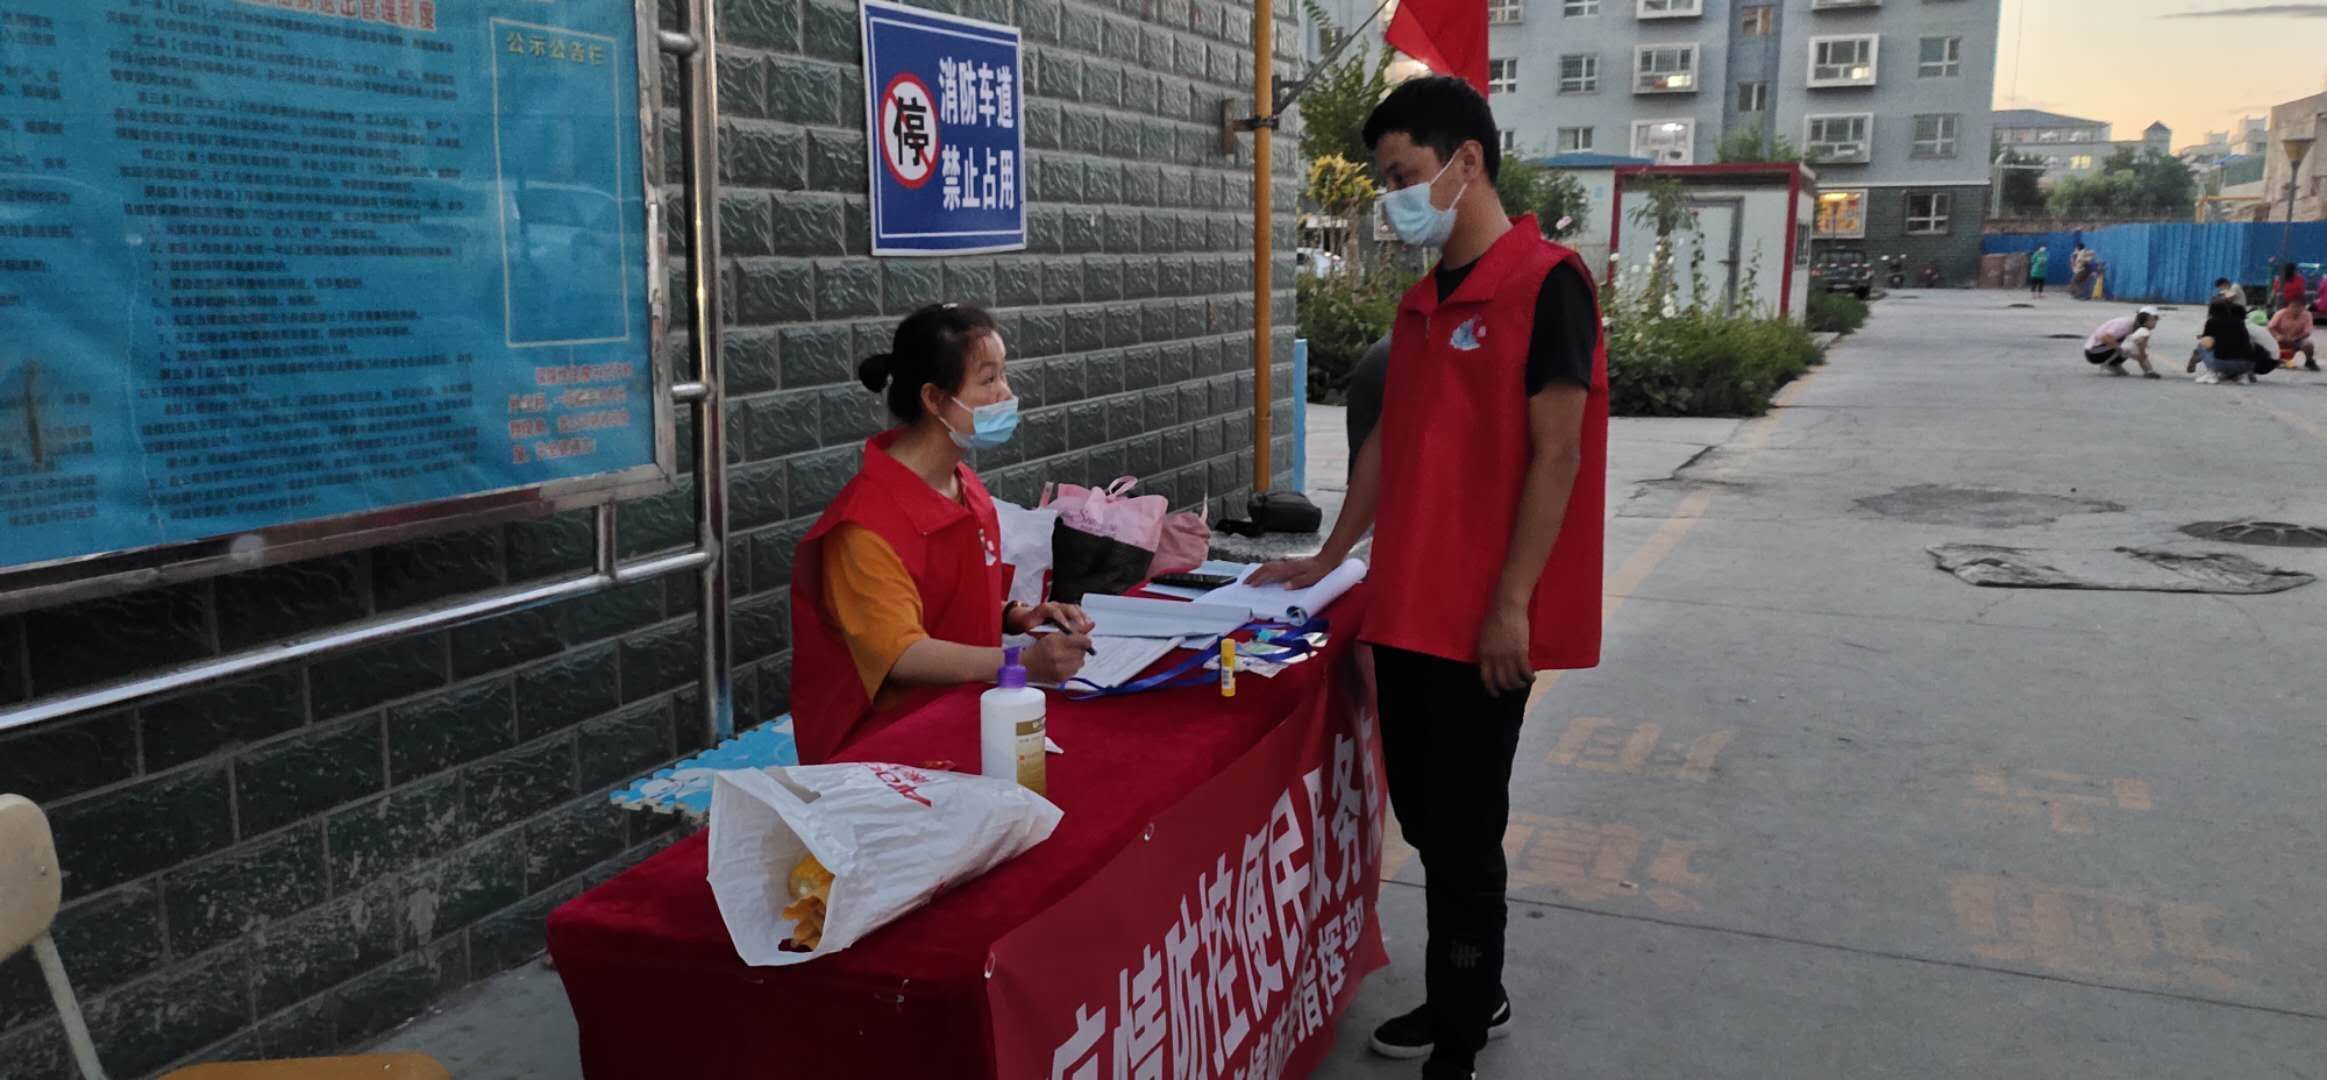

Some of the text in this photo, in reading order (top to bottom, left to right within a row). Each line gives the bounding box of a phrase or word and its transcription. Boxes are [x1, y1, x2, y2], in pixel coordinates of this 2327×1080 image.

[507, 31, 606, 65] 公示公告栏
[938, 56, 1014, 128] 消防车道
[893, 97, 928, 166] 停
[941, 144, 1014, 211] 禁止占用
